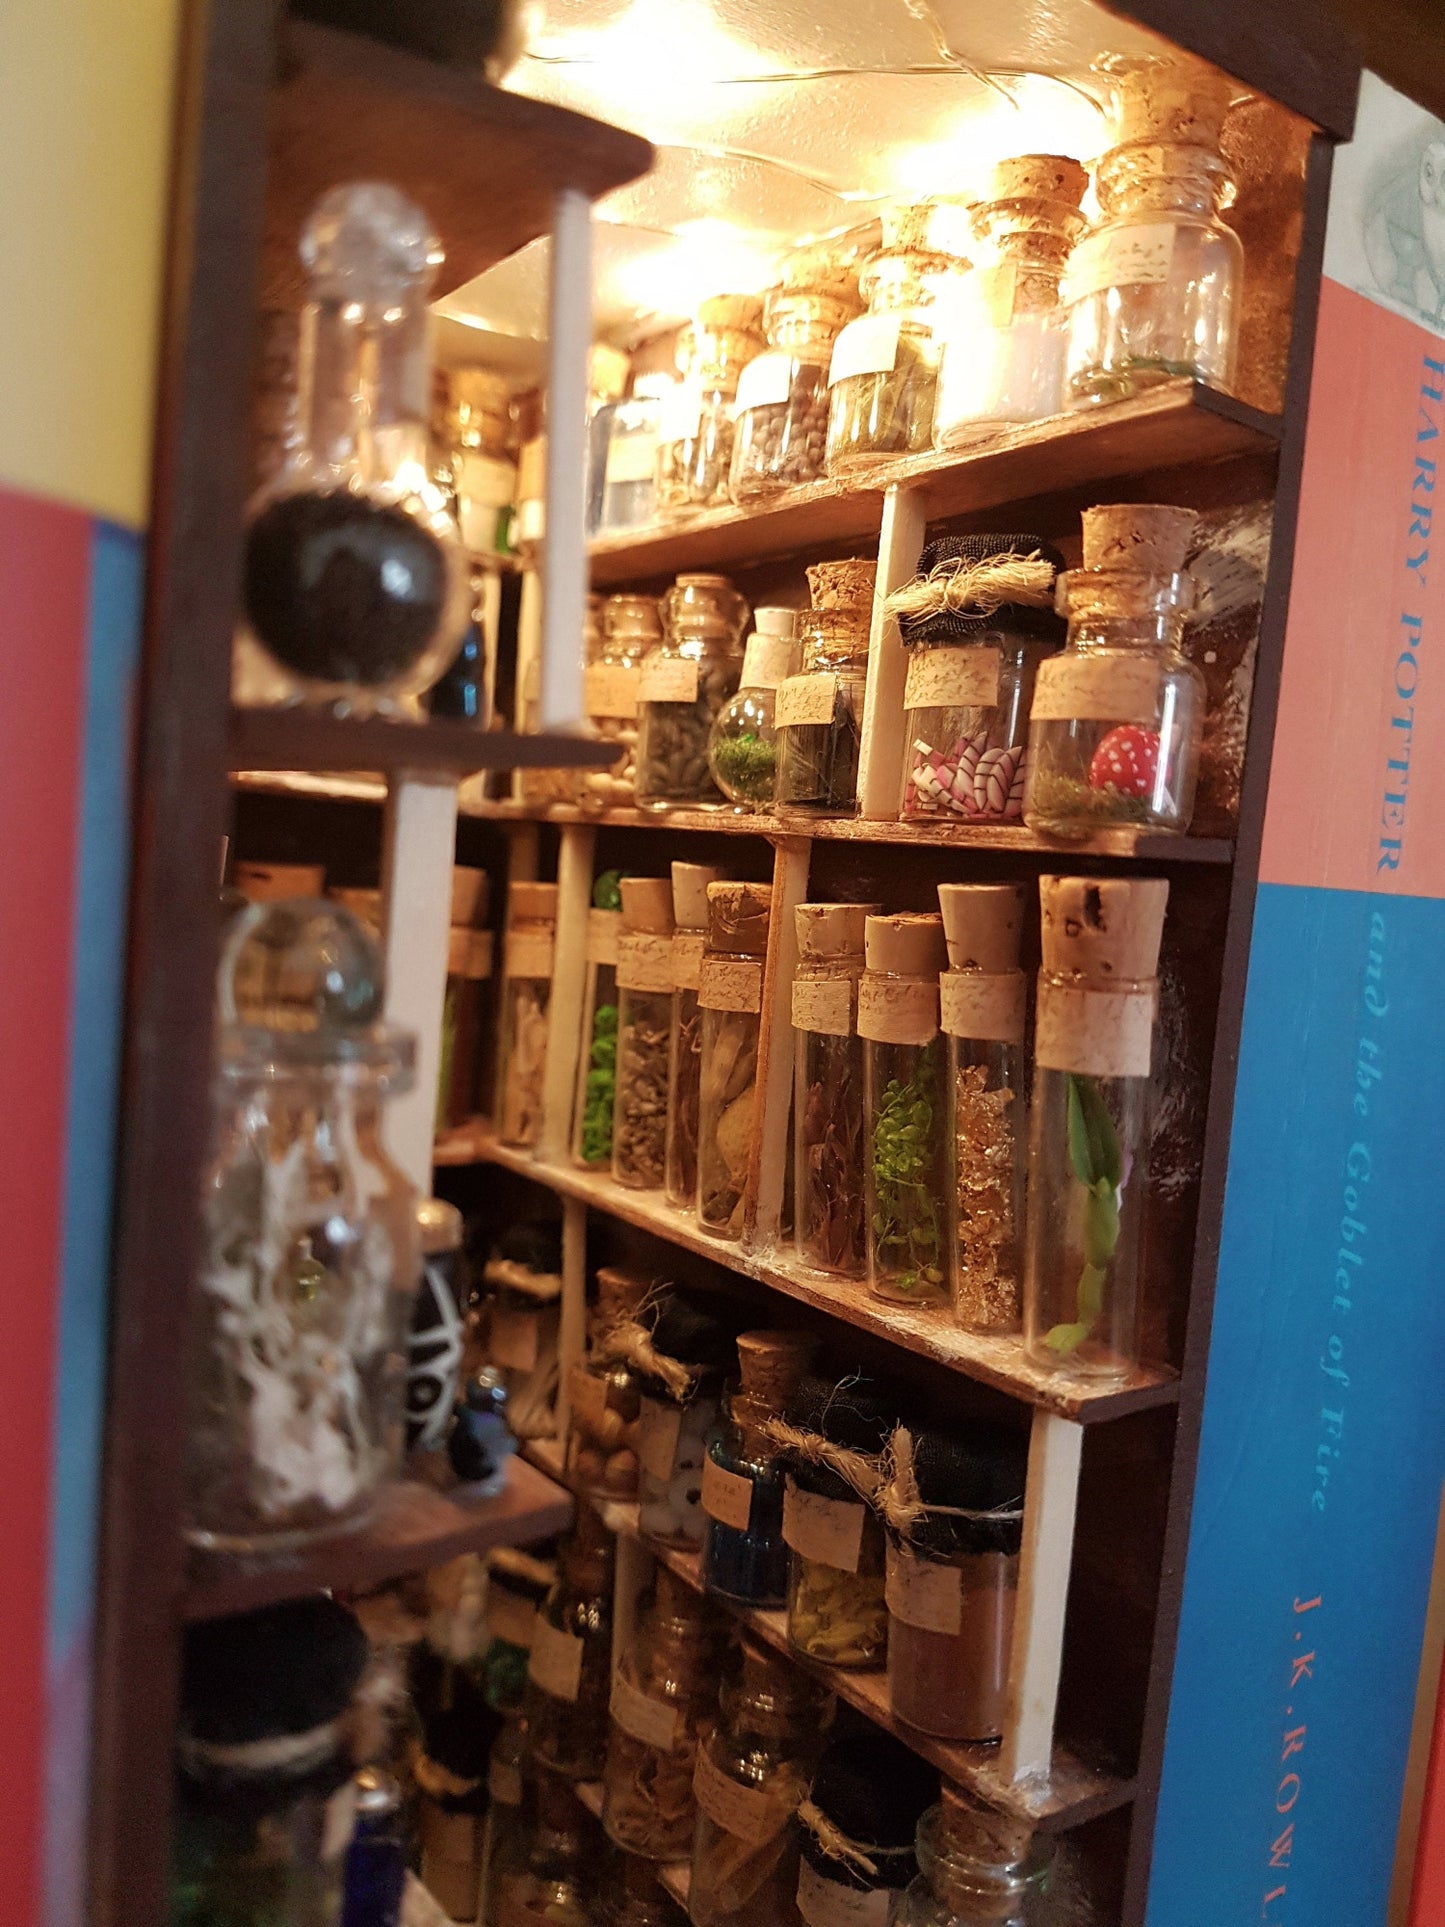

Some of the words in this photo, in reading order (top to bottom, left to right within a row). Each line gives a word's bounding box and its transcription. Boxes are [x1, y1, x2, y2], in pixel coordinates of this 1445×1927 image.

[1406, 354, 1445, 588] HARRY
[1376, 612, 1423, 875] POTTER
[1364, 911, 1389, 1017] and
[1353, 1037, 1383, 1117] the
[1332, 1141, 1371, 1316] Goblet
[1319, 1333, 1350, 1388] of
[1311, 1406, 1345, 1515] Fire
